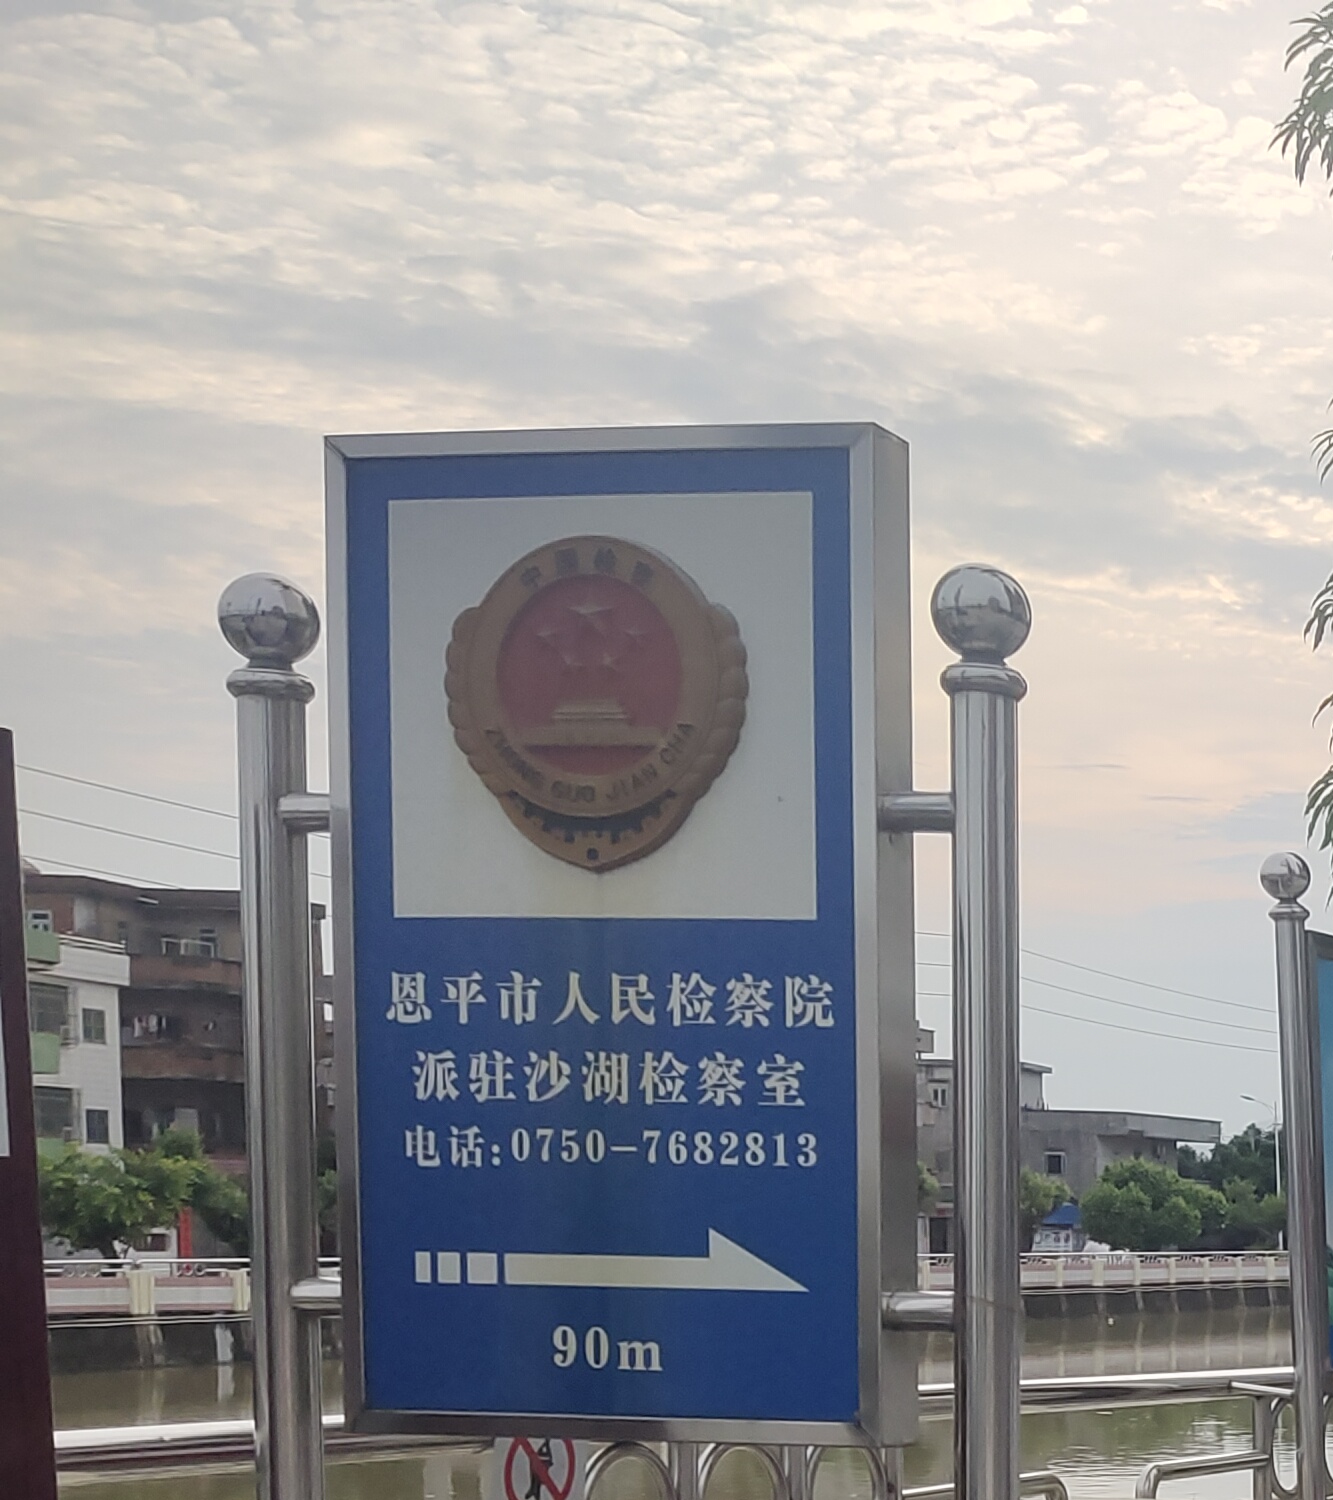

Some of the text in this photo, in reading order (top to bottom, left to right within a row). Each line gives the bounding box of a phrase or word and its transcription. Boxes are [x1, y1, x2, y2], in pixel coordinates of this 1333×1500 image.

[385, 970, 836, 1029] 恩平市人民检察院
[411, 1049, 807, 1107] 派驻沙湖检察室
[552, 1325, 664, 1372] 90m
